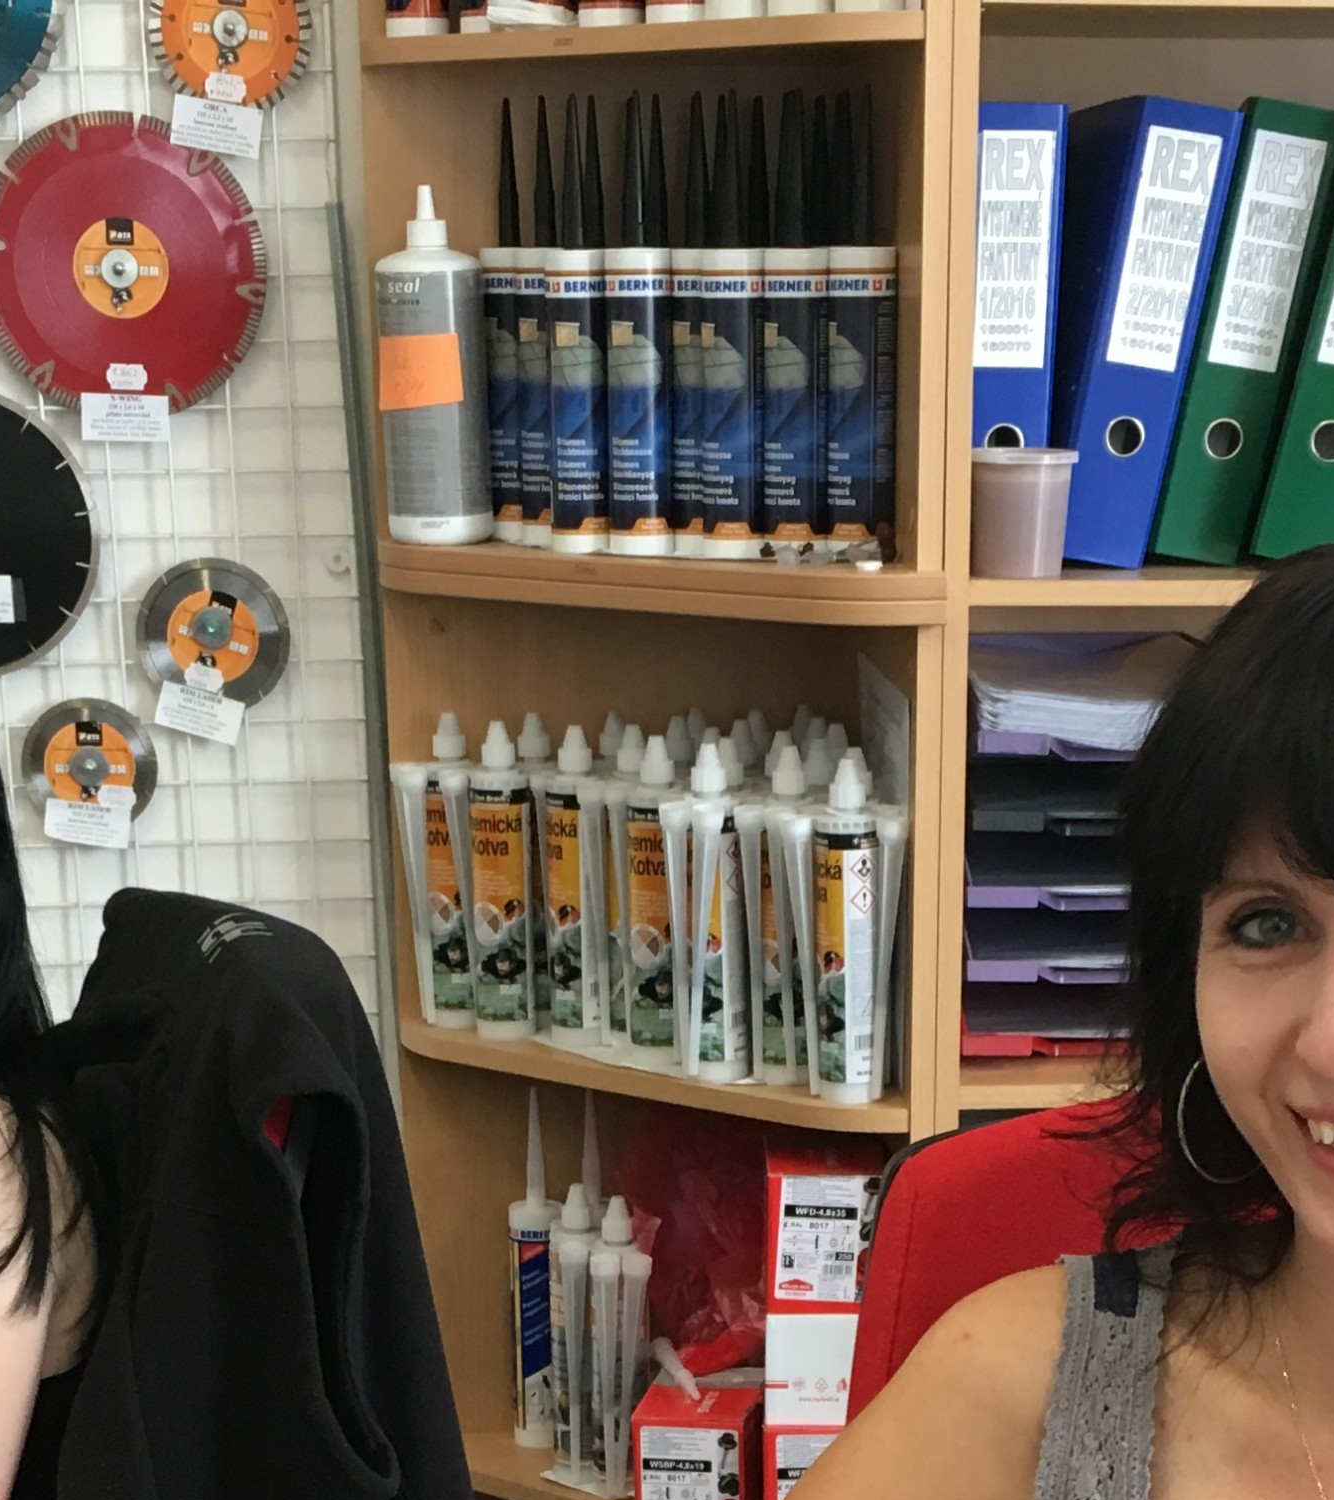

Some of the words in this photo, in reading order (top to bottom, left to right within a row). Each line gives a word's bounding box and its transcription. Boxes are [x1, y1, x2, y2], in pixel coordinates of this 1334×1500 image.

[985, 138, 1046, 190] REX
[1149, 135, 1218, 195] REX
[1255, 140, 1326, 199] REX
[980, 242, 1041, 281] FAKTURY
[1131, 238, 1198, 283] FAKTURY
[485, 278, 514, 290] BERN
[619, 279, 664, 291] BERNER
[704, 280, 747, 292] BERNER
[767, 280, 812, 292] BERNER
[979, 286, 1036, 319] 1/2016
[1125, 283, 1188, 322] 2/2016
[1227, 284, 1286, 325] 3/2016
[1121, 336, 1173, 353] 160140
[471, 814, 523, 834] emická
[427, 829, 451, 846] otv
[809, 1222, 829, 1230] 8017
[667, 1474, 687, 1482] 8017
